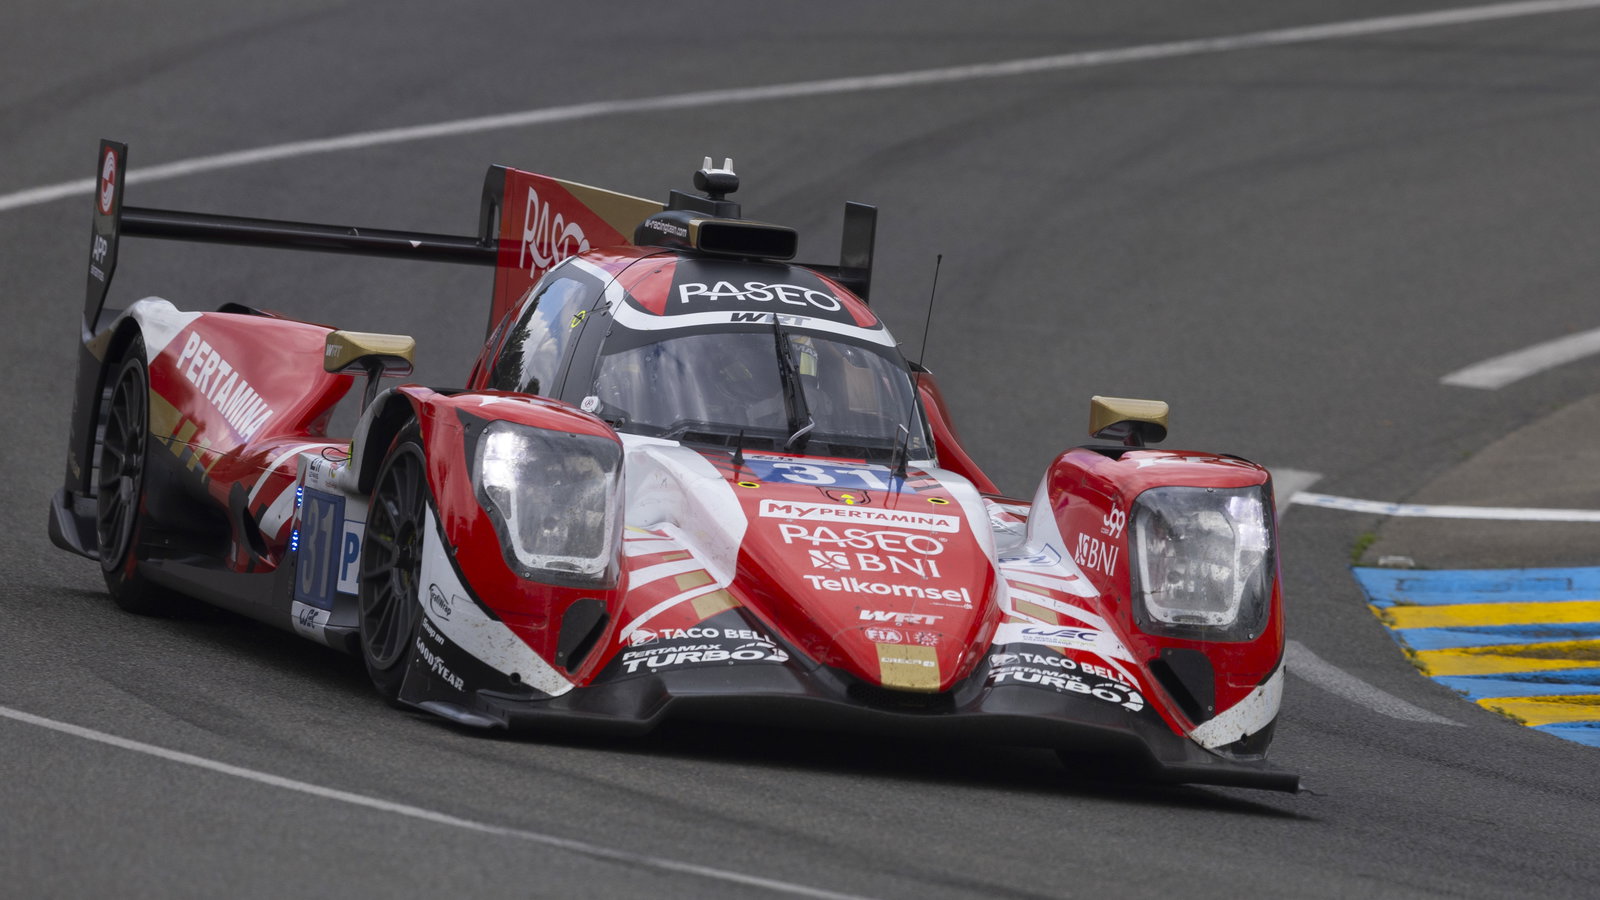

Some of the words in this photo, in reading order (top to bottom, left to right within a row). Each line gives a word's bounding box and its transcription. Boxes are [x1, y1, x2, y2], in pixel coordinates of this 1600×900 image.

[678, 281, 841, 312] PASEO
[730, 312, 811, 326] WRT
[175, 330, 274, 442] PERTAMINA
[773, 463, 889, 490] 31
[301, 499, 336, 598] 31
[777, 523, 945, 556] PASEO
[341, 531, 361, 585] P
[854, 552, 942, 578] BNI
[1087, 537, 1119, 577] BNI
[803, 574, 972, 604] Telkomsel
[859, 609, 944, 625] WRT
[659, 628, 720, 640] TACO
[724, 629, 777, 646] BELL
[866, 628, 900, 642] FIA
[1021, 627, 1098, 642] WEC
[416, 636, 465, 692] GOODYEAR
[622, 643, 722, 661] PERTAMAX
[622, 649, 767, 674] TURBO
[988, 665, 1082, 682] PERTAMAX
[1019, 652, 1077, 670] TACO
[1080, 661, 1131, 687] BELL
[989, 671, 1123, 703] TURBO
